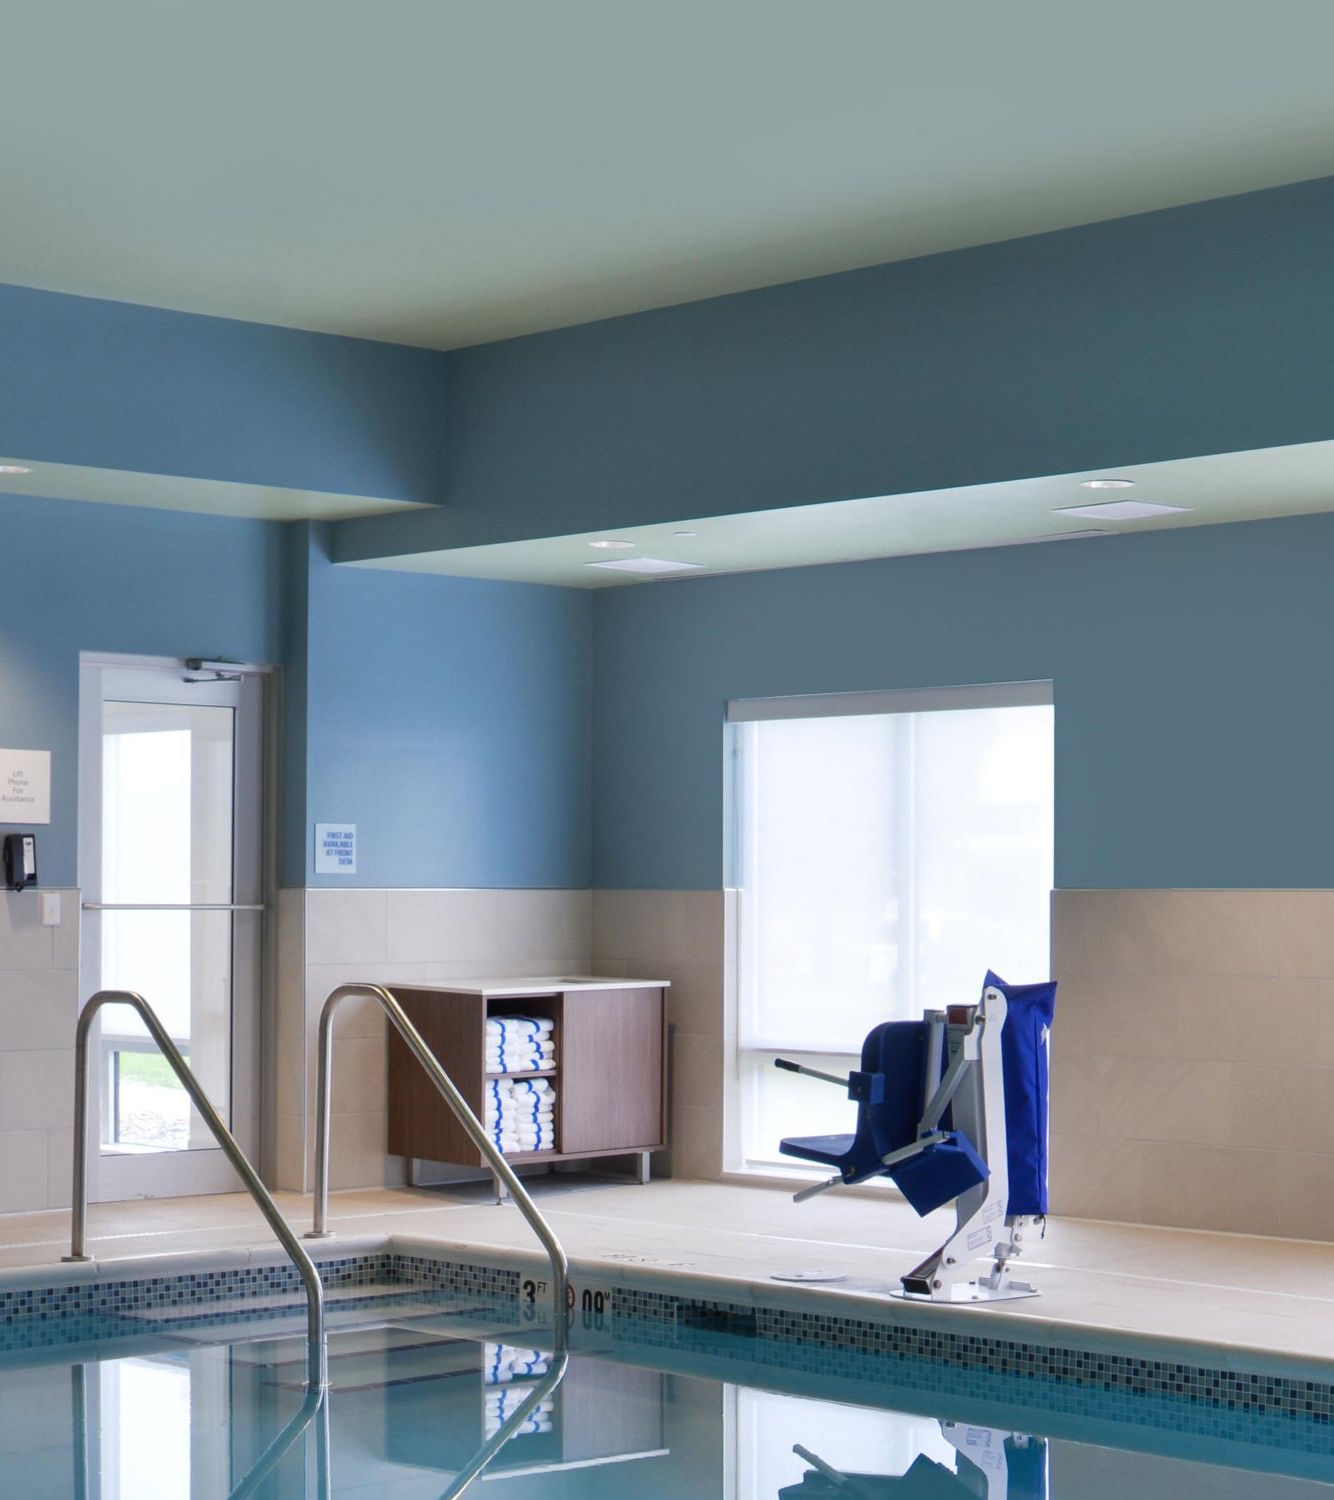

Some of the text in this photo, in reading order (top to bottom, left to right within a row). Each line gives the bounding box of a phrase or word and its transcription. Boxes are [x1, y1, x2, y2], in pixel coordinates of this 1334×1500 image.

[12, 770, 24, 778] Lift
[7, 778, 29, 787] Phone
[12, 786, 24, 794] For
[1, 795, 35, 803] Assistance
